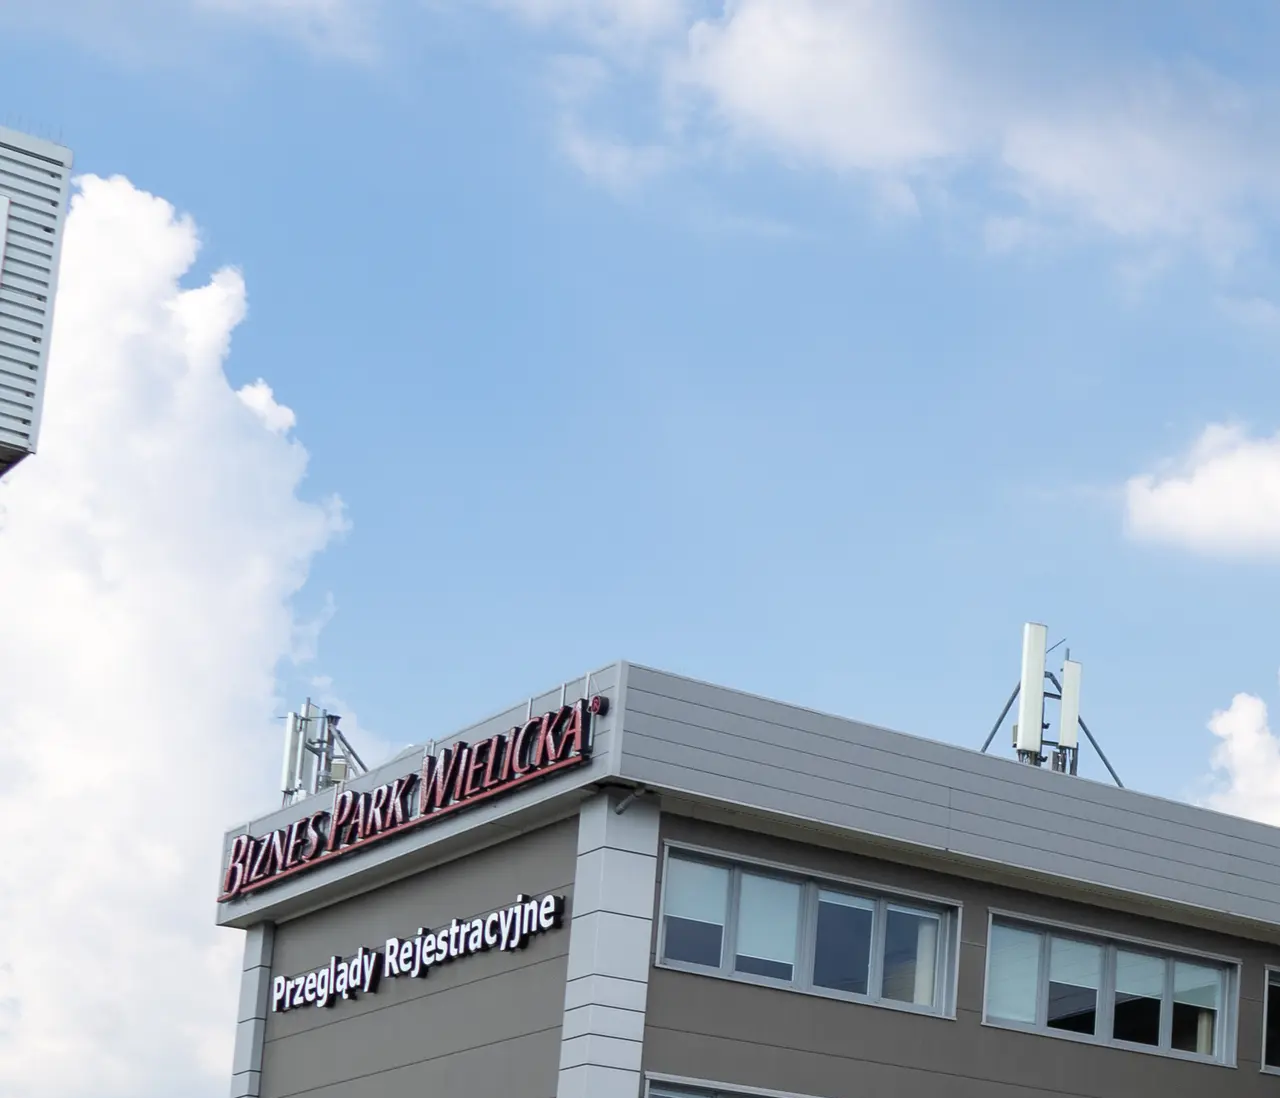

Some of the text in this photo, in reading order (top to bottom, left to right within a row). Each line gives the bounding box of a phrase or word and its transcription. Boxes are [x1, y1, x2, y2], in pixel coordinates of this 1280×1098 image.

[223, 810, 329, 895] BIZNES
[327, 775, 415, 852] PARK
[272, 894, 557, 1013] Przeglądy Rejestracyjne
